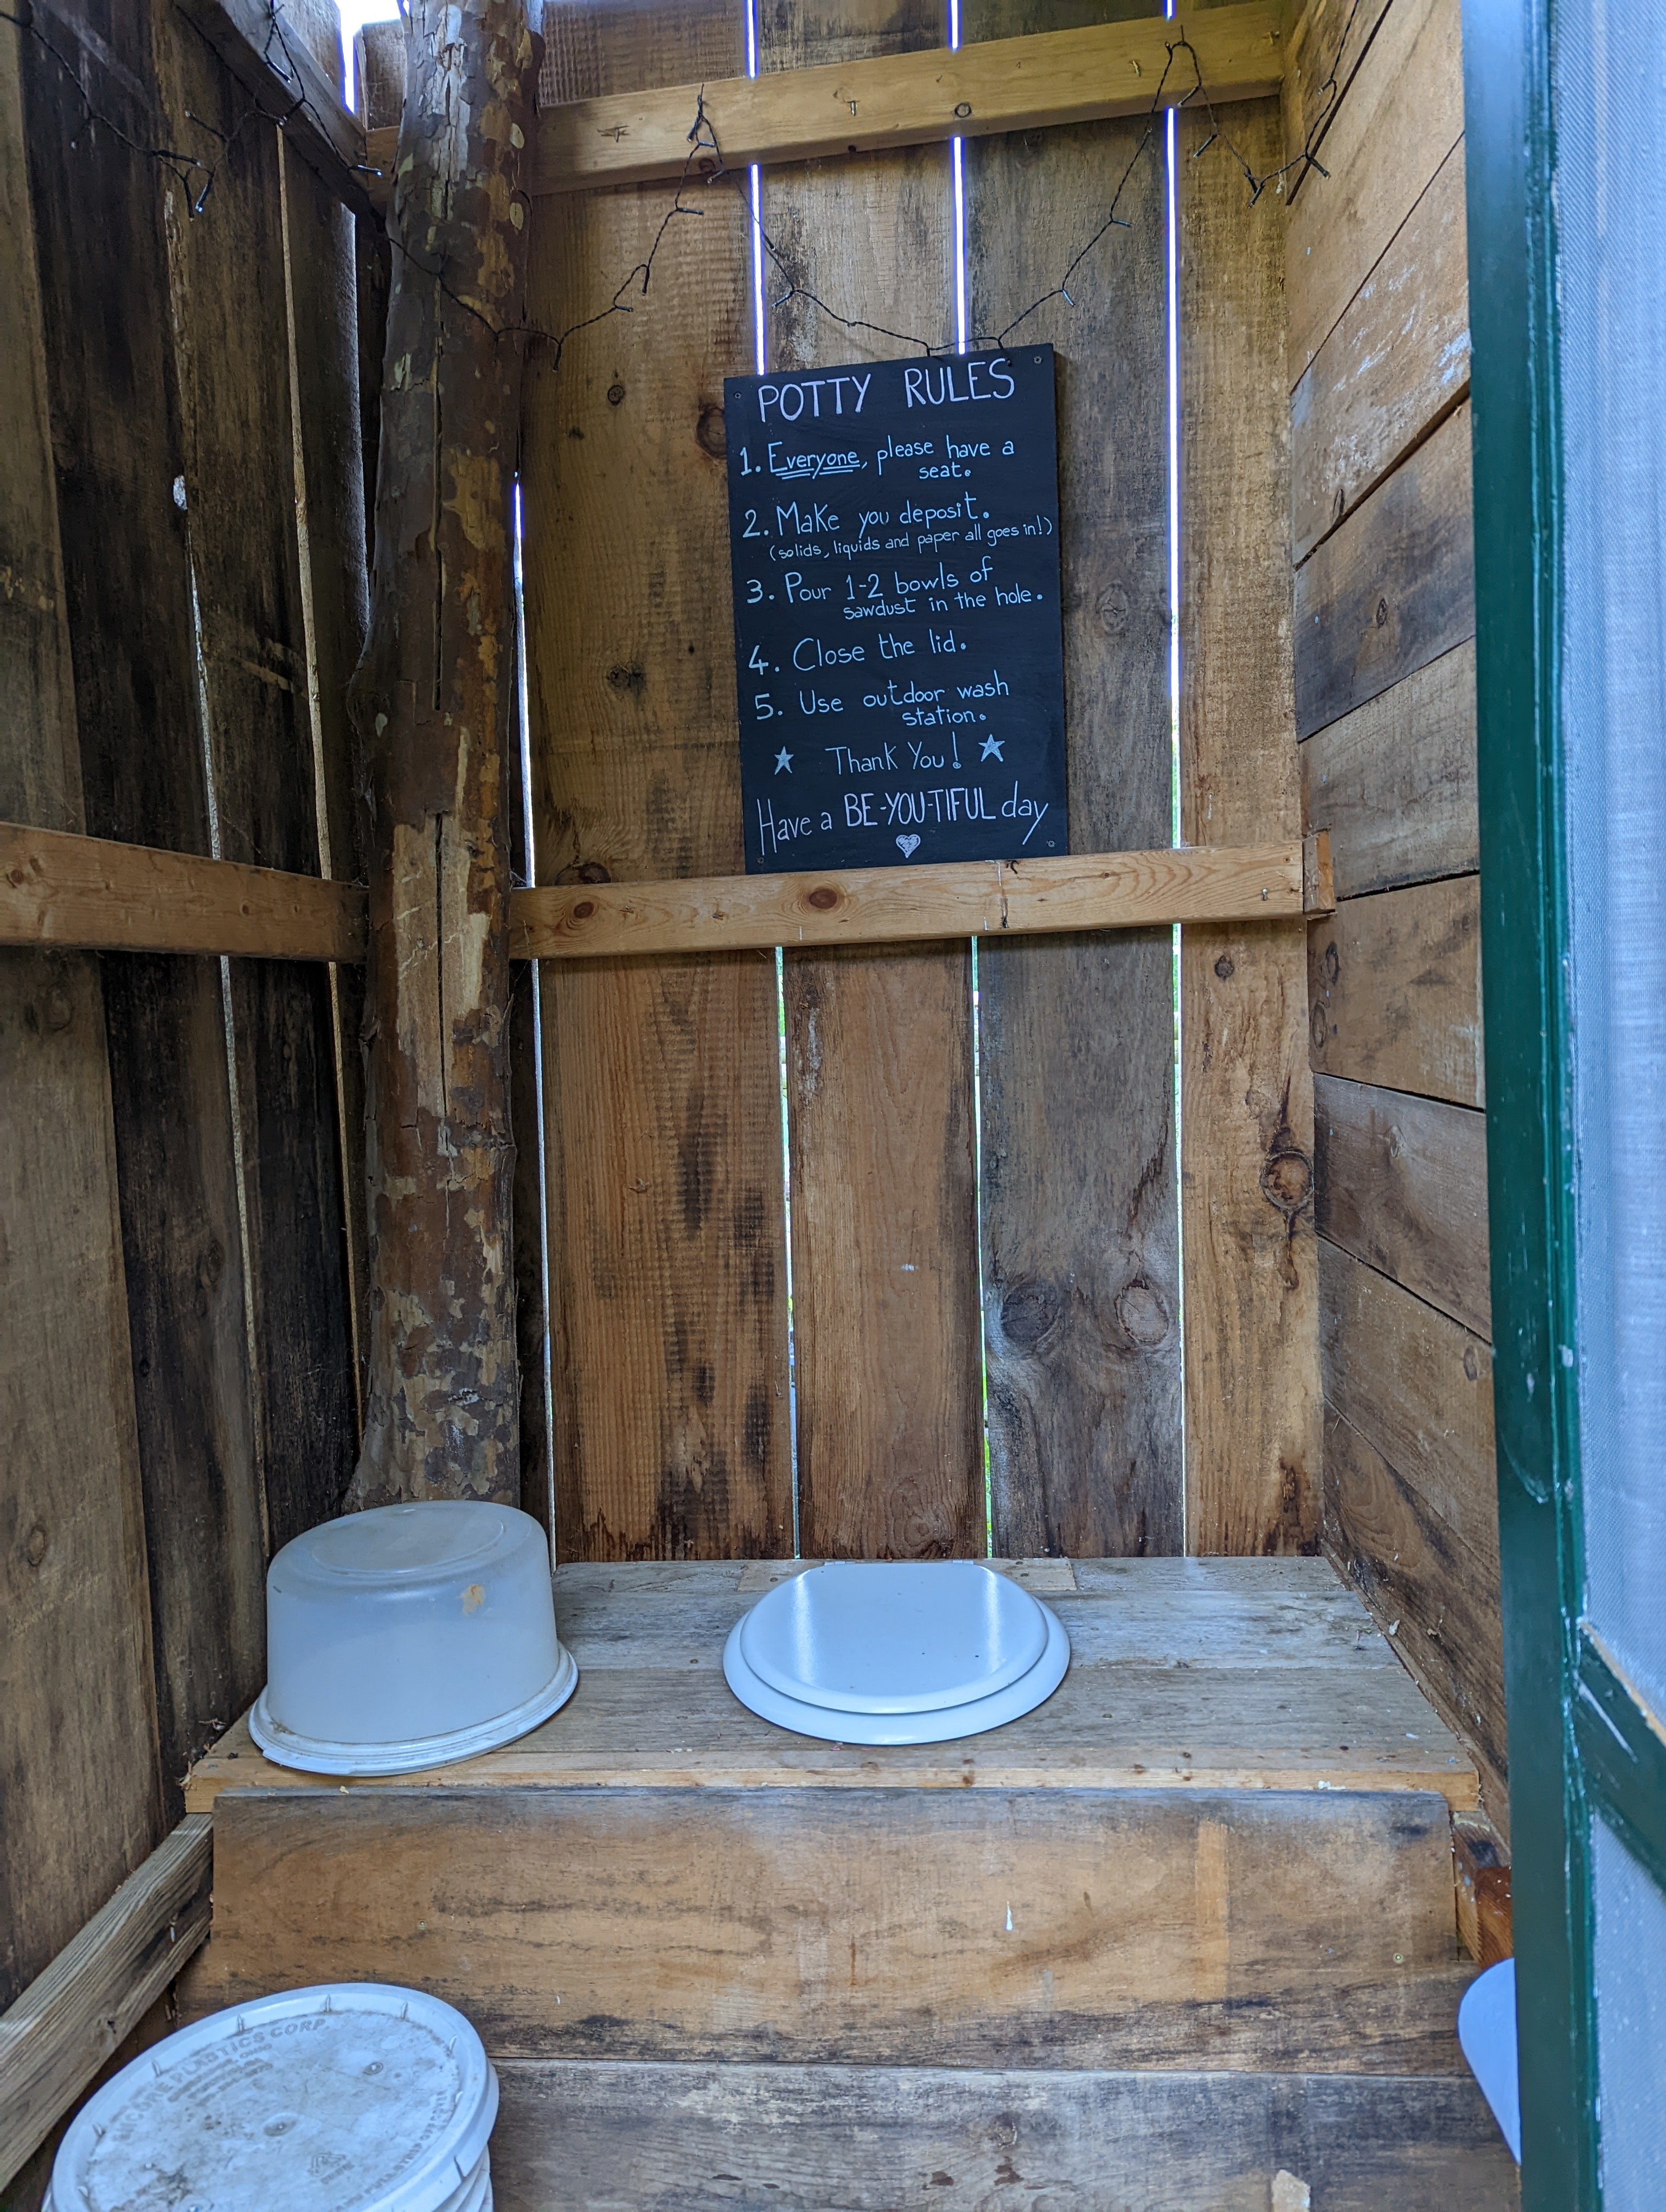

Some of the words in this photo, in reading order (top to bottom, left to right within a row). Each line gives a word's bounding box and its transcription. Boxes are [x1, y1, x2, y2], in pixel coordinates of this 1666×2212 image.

[758, 374, 871, 422] POTTY
[904, 358, 1015, 408] RULES
[740, 447, 761, 476] 1.
[768, 441, 868, 480] Everyone,
[877, 435, 934, 475] please
[946, 434, 991, 459] have
[1002, 441, 1015, 455] a
[919, 461, 971, 479] seat.
[742, 509, 769, 538] 2.
[858, 511, 889, 538] you
[899, 491, 989, 530] deposit.
[770, 544, 830, 561] (solids,
[834, 538, 880, 561] liquids
[885, 532, 909, 549] and
[918, 531, 960, 554] paper
[965, 523, 982, 541] all
[987, 526, 1020, 546] goes
[746, 579, 774, 603] 3.
[785, 571, 831, 603] Pour
[846, 574, 883, 600] 1-2
[894, 562, 960, 595] bowls
[970, 556, 993, 583] of
[843, 598, 917, 620] sawdust
[928, 597, 948, 612] in
[957, 592, 986, 609] the
[995, 585, 1043, 606] hole.
[748, 645, 780, 675] 4.
[793, 638, 865, 671] Close
[878, 633, 915, 659] the
[929, 628, 966, 654] lid.
[755, 693, 783, 720] 5.
[799, 690, 843, 715] Use
[863, 679, 945, 707] outdoor
[956, 670, 1009, 698] wash
[902, 706, 986, 726] station.
[757, 799, 812, 856] Have
[821, 812, 832, 830] a
[1001, 780, 1049, 845] day
[171, 2031, 265, 2083] PLASTICS
[271, 2018, 330, 2038] CORP.
